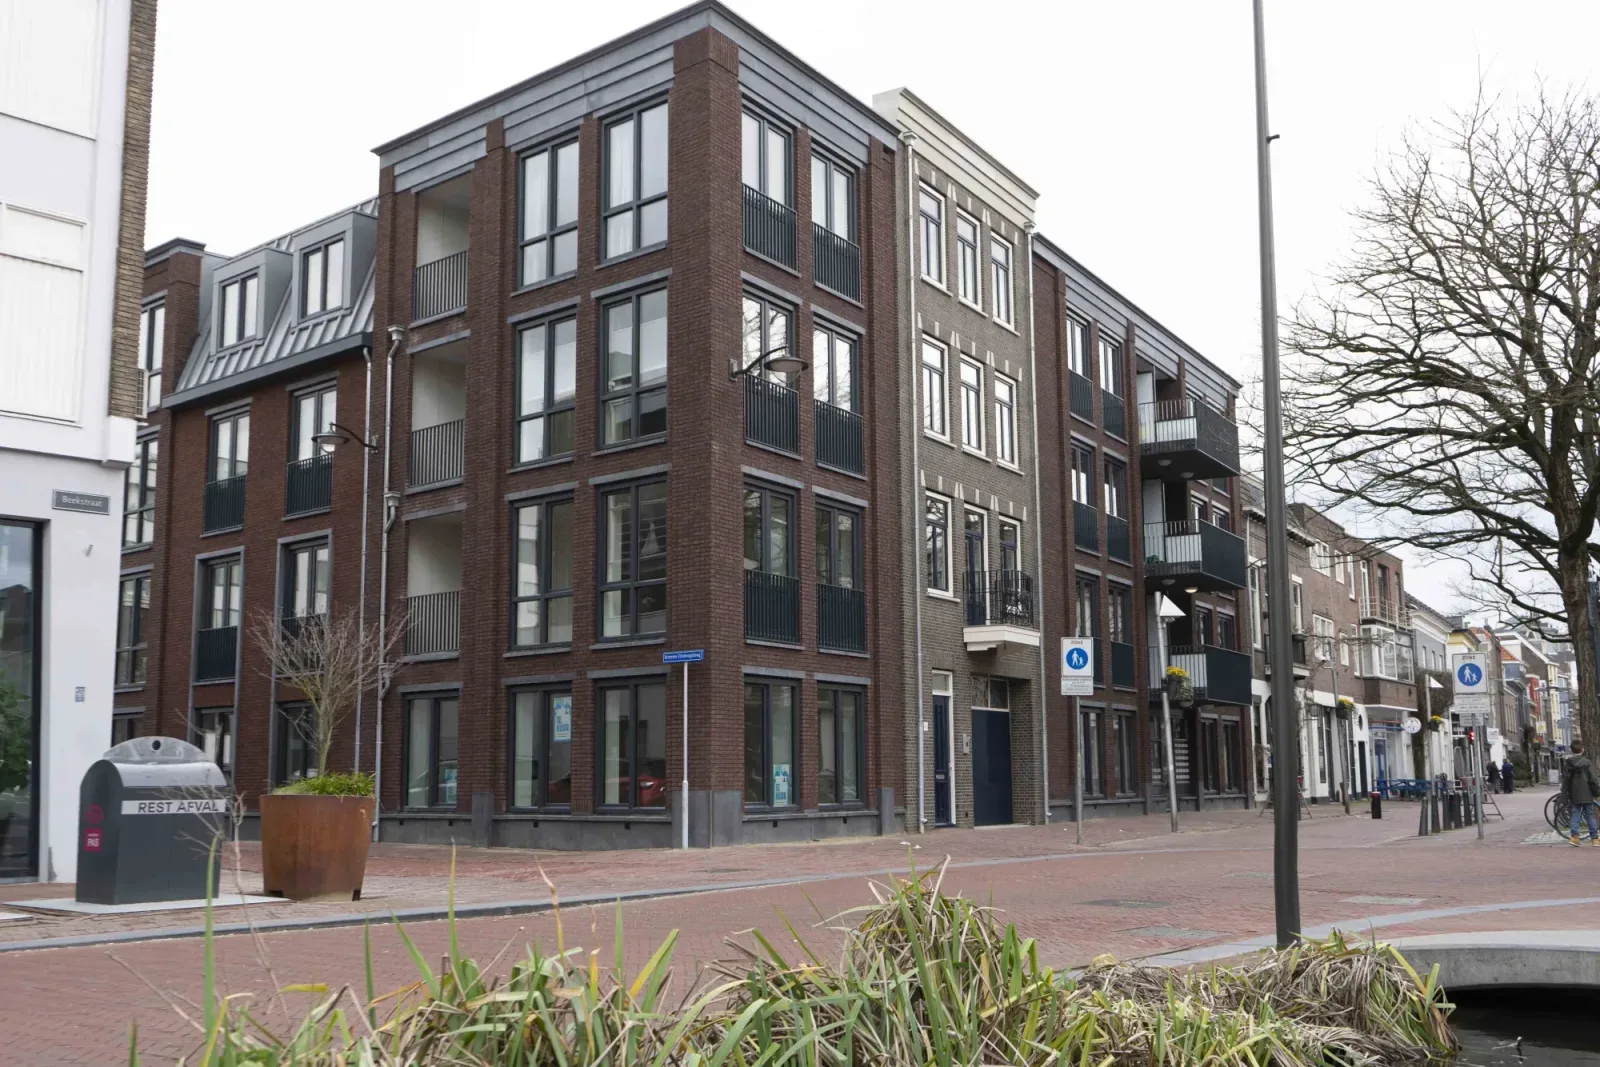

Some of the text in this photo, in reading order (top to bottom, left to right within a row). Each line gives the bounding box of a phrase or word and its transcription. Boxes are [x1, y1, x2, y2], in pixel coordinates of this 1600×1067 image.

[62, 495, 103, 507] Beekstraat
[138, 801, 218, 813] REST AFVAL
